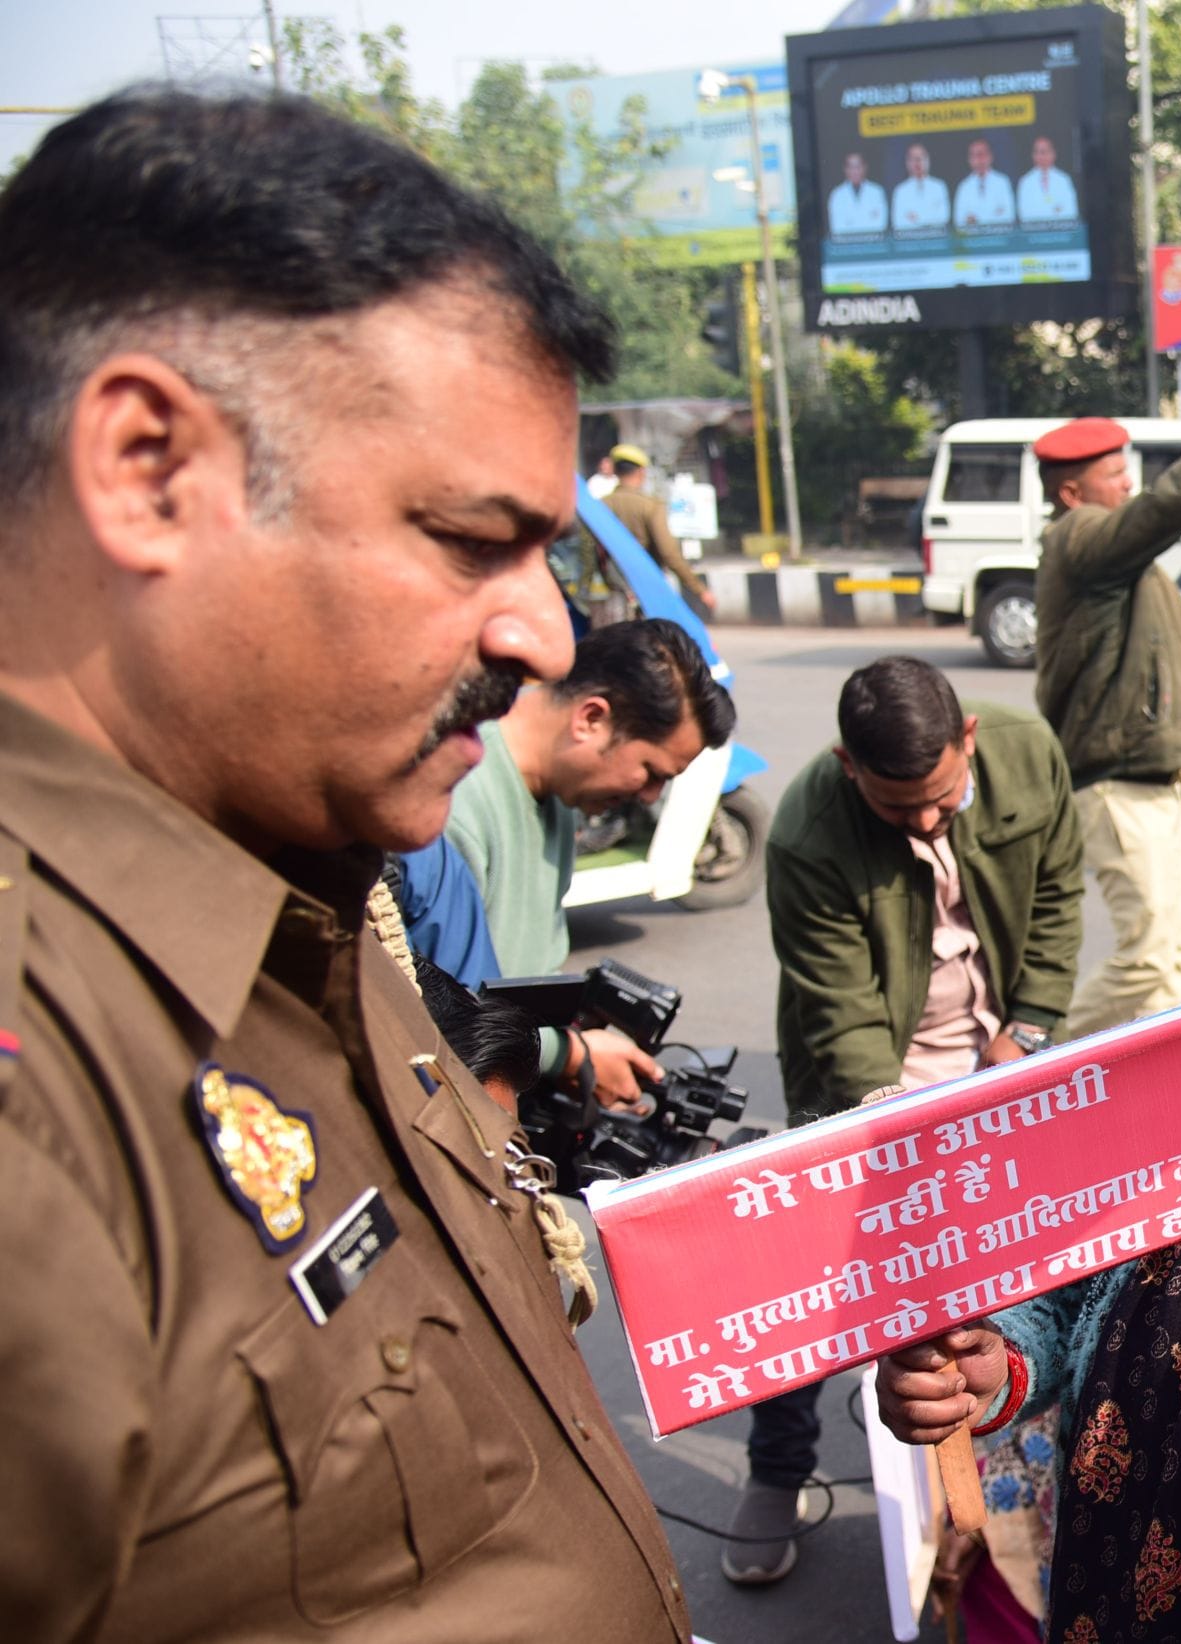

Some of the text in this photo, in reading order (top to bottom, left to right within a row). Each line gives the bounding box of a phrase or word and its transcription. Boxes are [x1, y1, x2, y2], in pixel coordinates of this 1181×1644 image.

[841, 70, 1051, 108] APOLLO TRAUMA CENTRE
[817, 296, 921, 326] ADINDIA
[727, 1064, 1110, 1220] मेरे पापा अपराधी
[854, 1170, 948, 1236] नहीं
[644, 1329, 710, 1368] मा.
[715, 1260, 877, 1353] मुख्यमंत्री
[878, 1225, 967, 1284] योगी
[975, 1160, 1165, 1254] आदित्यनाथ
[681, 1364, 752, 1409] मेरे
[754, 1323, 874, 1383] पापा
[874, 1298, 930, 1340] के
[935, 1261, 1038, 1320] साथ
[1043, 1219, 1150, 1276] न्याय
